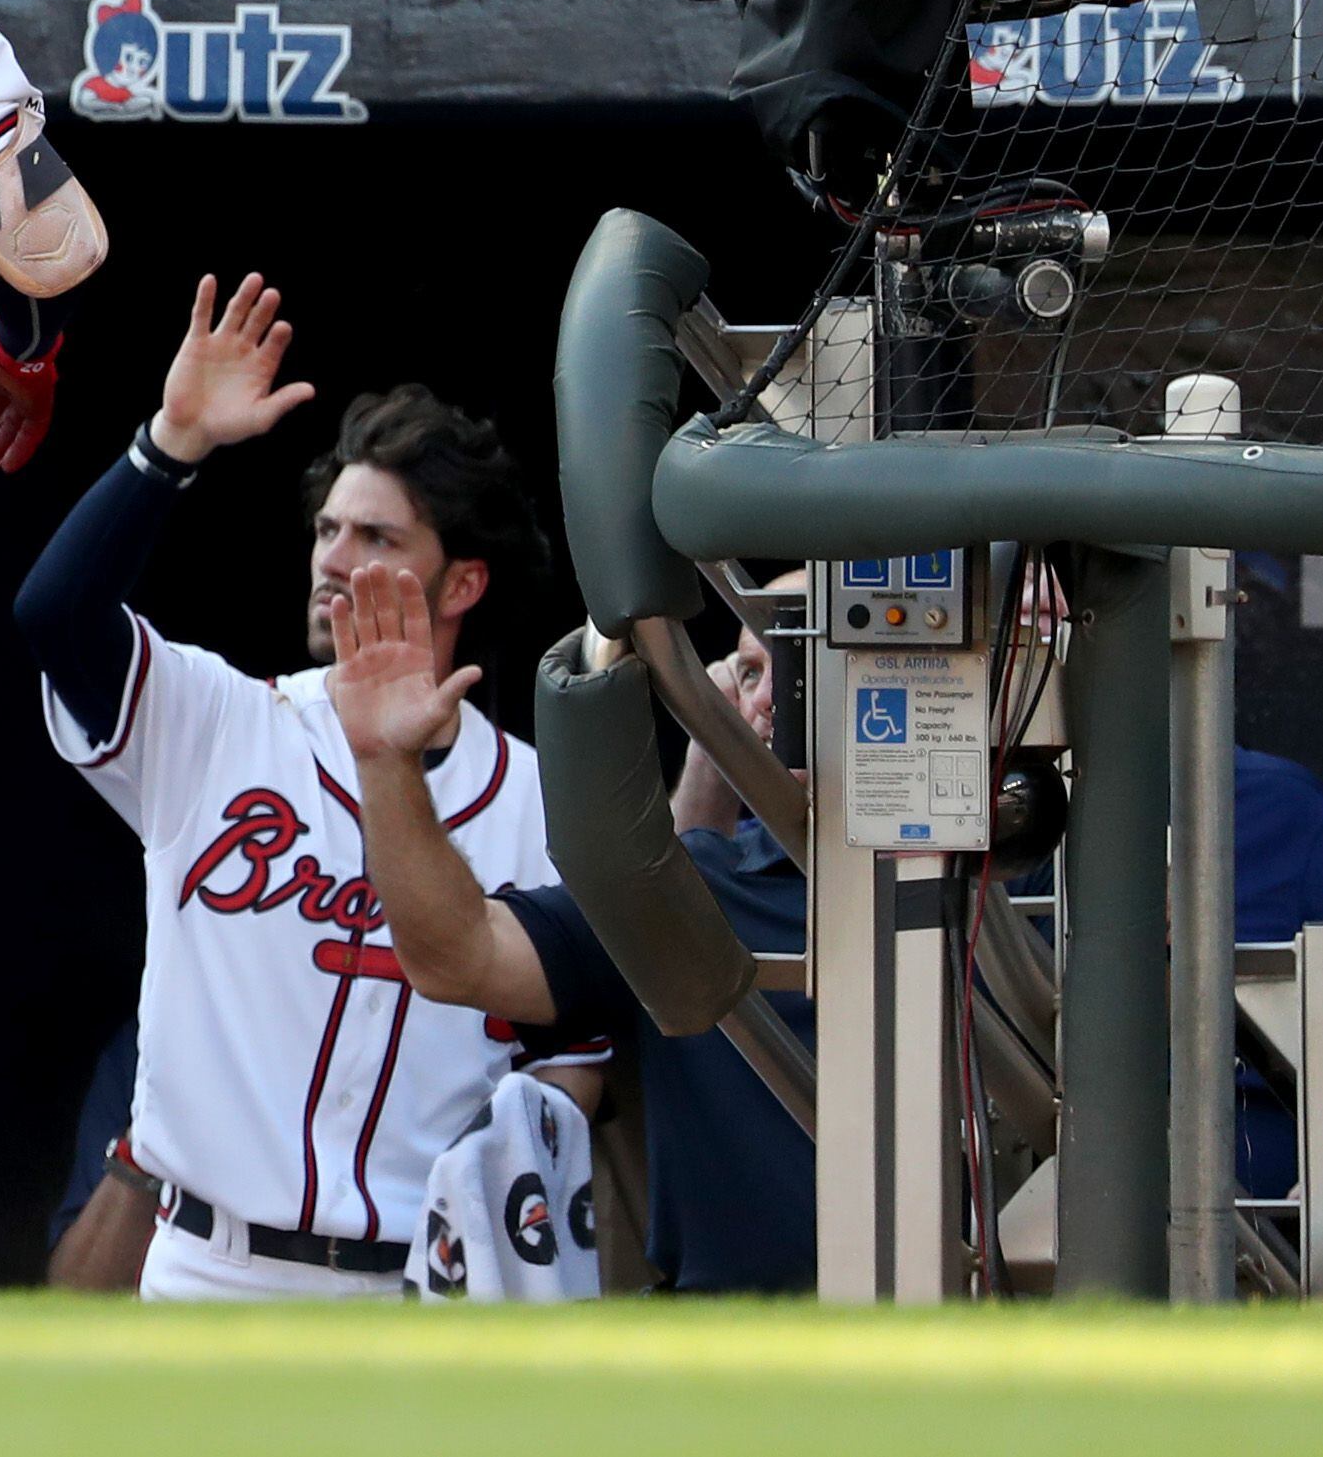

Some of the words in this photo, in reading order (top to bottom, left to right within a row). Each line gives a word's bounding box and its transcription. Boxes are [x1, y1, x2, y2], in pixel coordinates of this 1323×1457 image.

[875, 656, 900, 670] GSL
[915, 690, 932, 699] One
[915, 706, 927, 714] No
